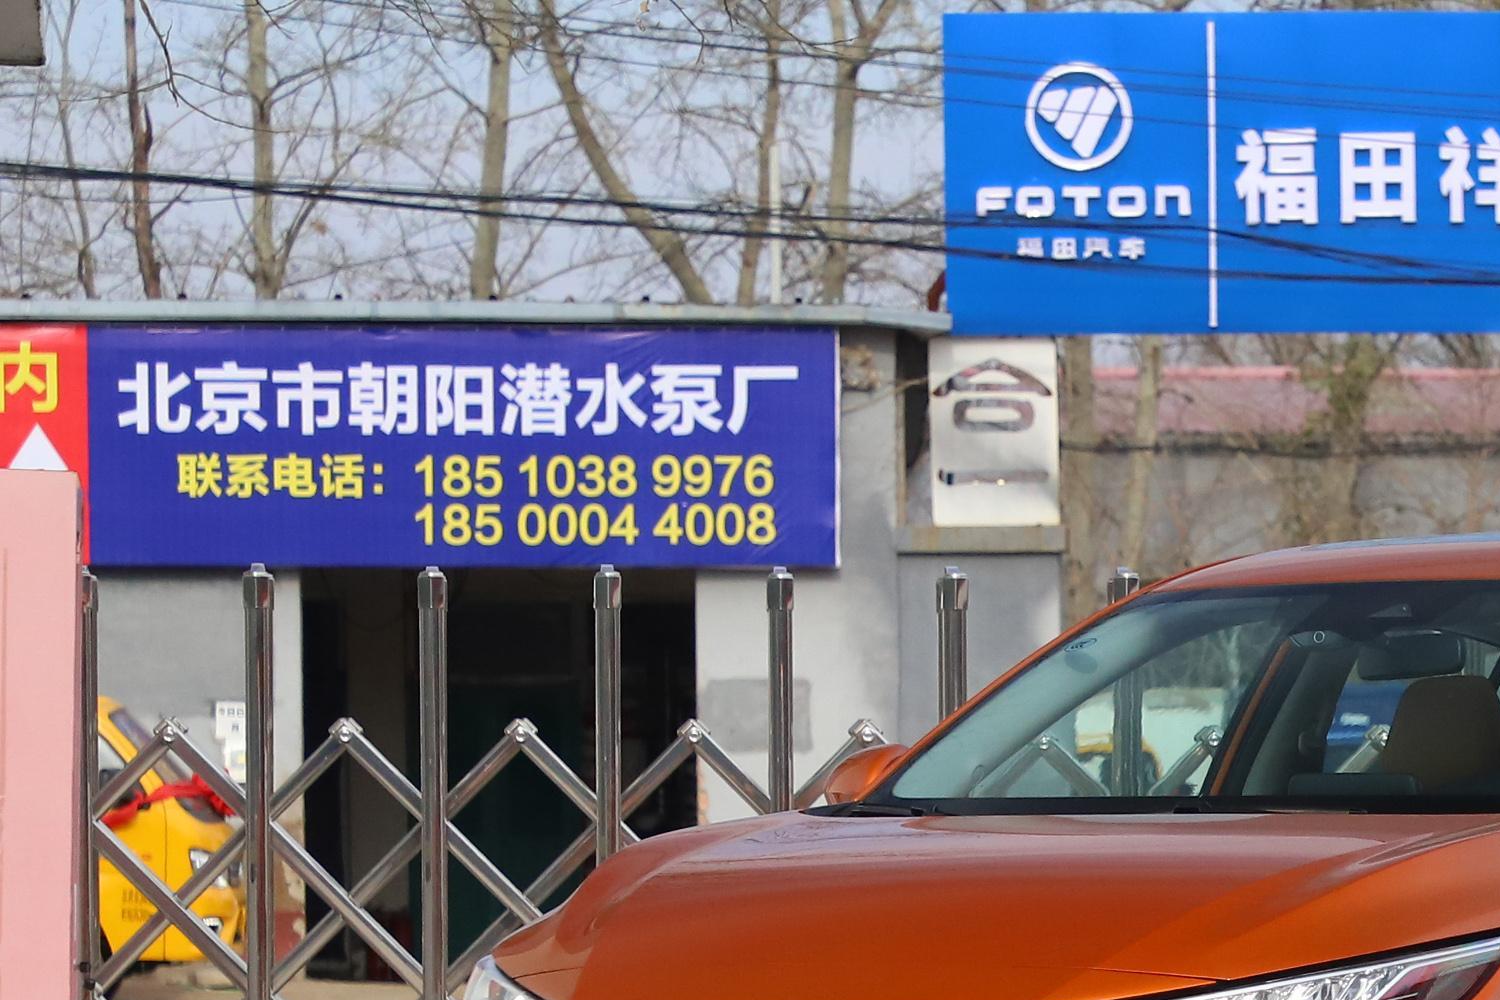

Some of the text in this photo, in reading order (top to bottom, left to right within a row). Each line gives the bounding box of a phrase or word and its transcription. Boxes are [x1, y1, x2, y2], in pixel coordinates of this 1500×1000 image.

[0, 340, 58, 413] 内
[117, 361, 799, 437] 北京市朝阳潜水泵厂
[176, 452, 774, 500] 联系电话： 185 1038 9976
[414, 502, 777, 547] 185 0004 4008
